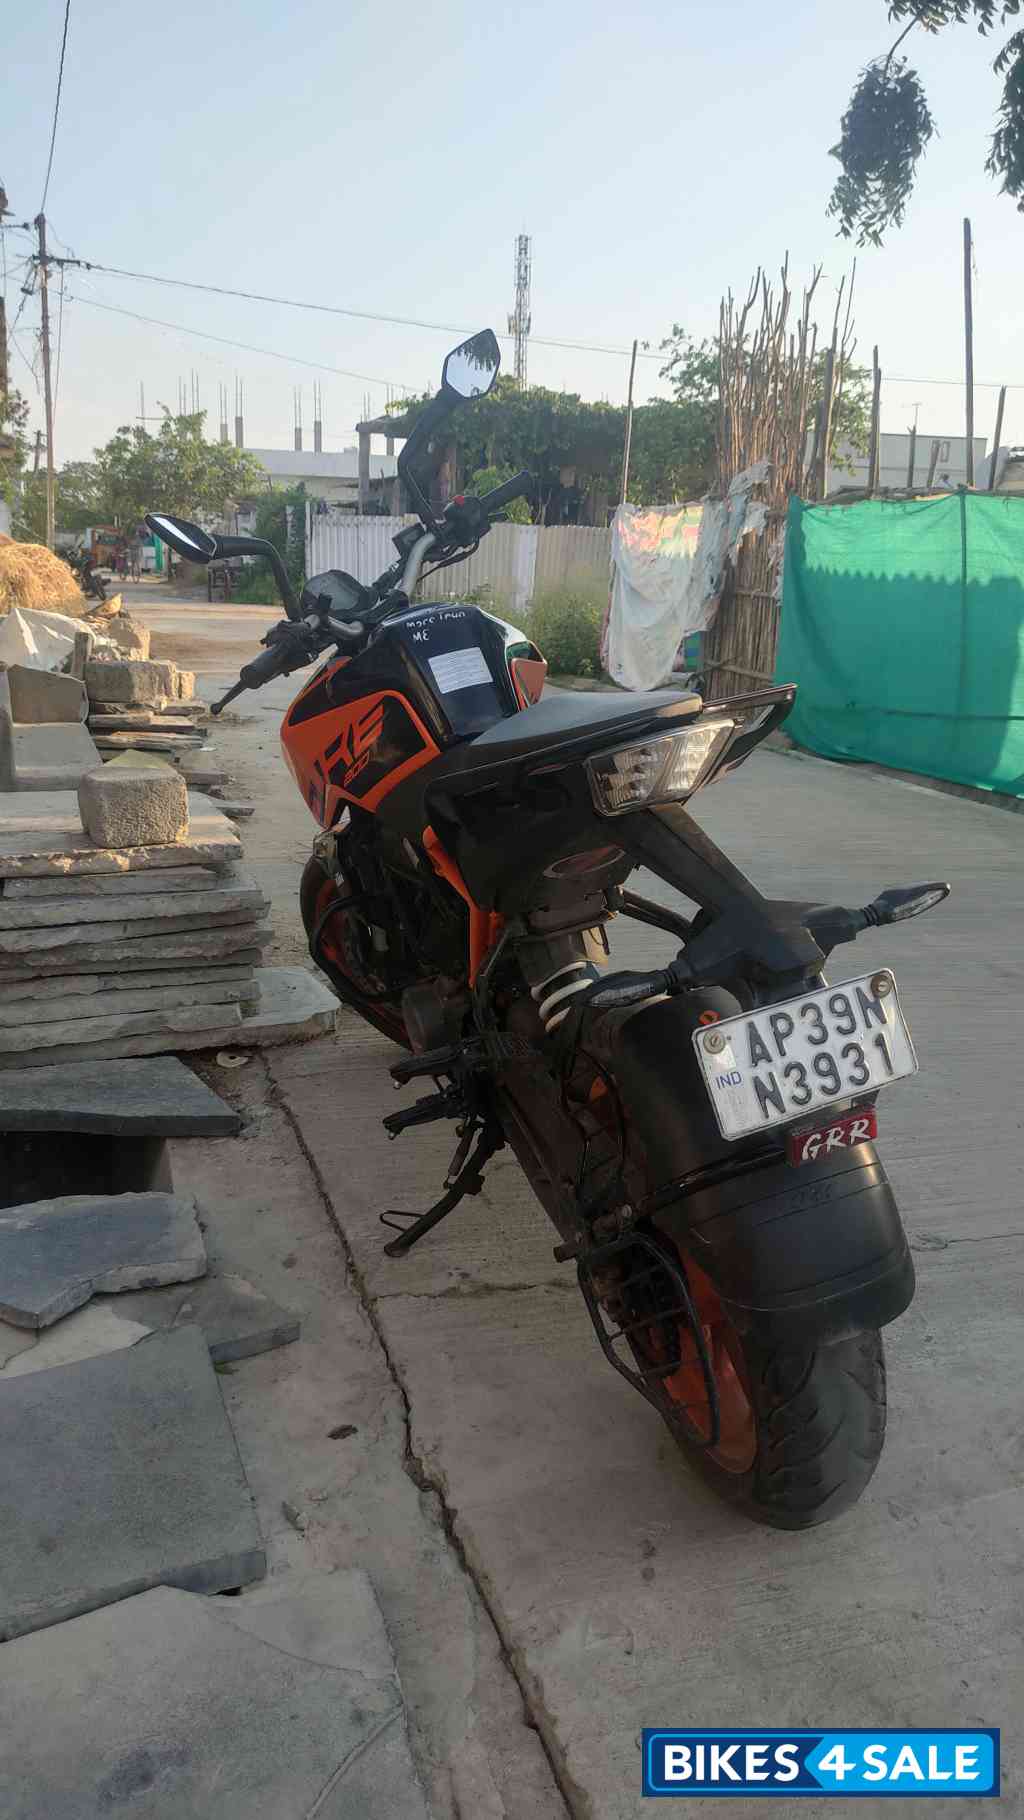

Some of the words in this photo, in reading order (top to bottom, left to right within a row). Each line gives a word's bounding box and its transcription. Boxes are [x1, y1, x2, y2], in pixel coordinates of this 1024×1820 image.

[745, 986, 888, 1067] AP39N
[715, 1071, 742, 1090] IND
[753, 1032, 895, 1119] N3931
[801, 1118, 871, 1160] GRR
